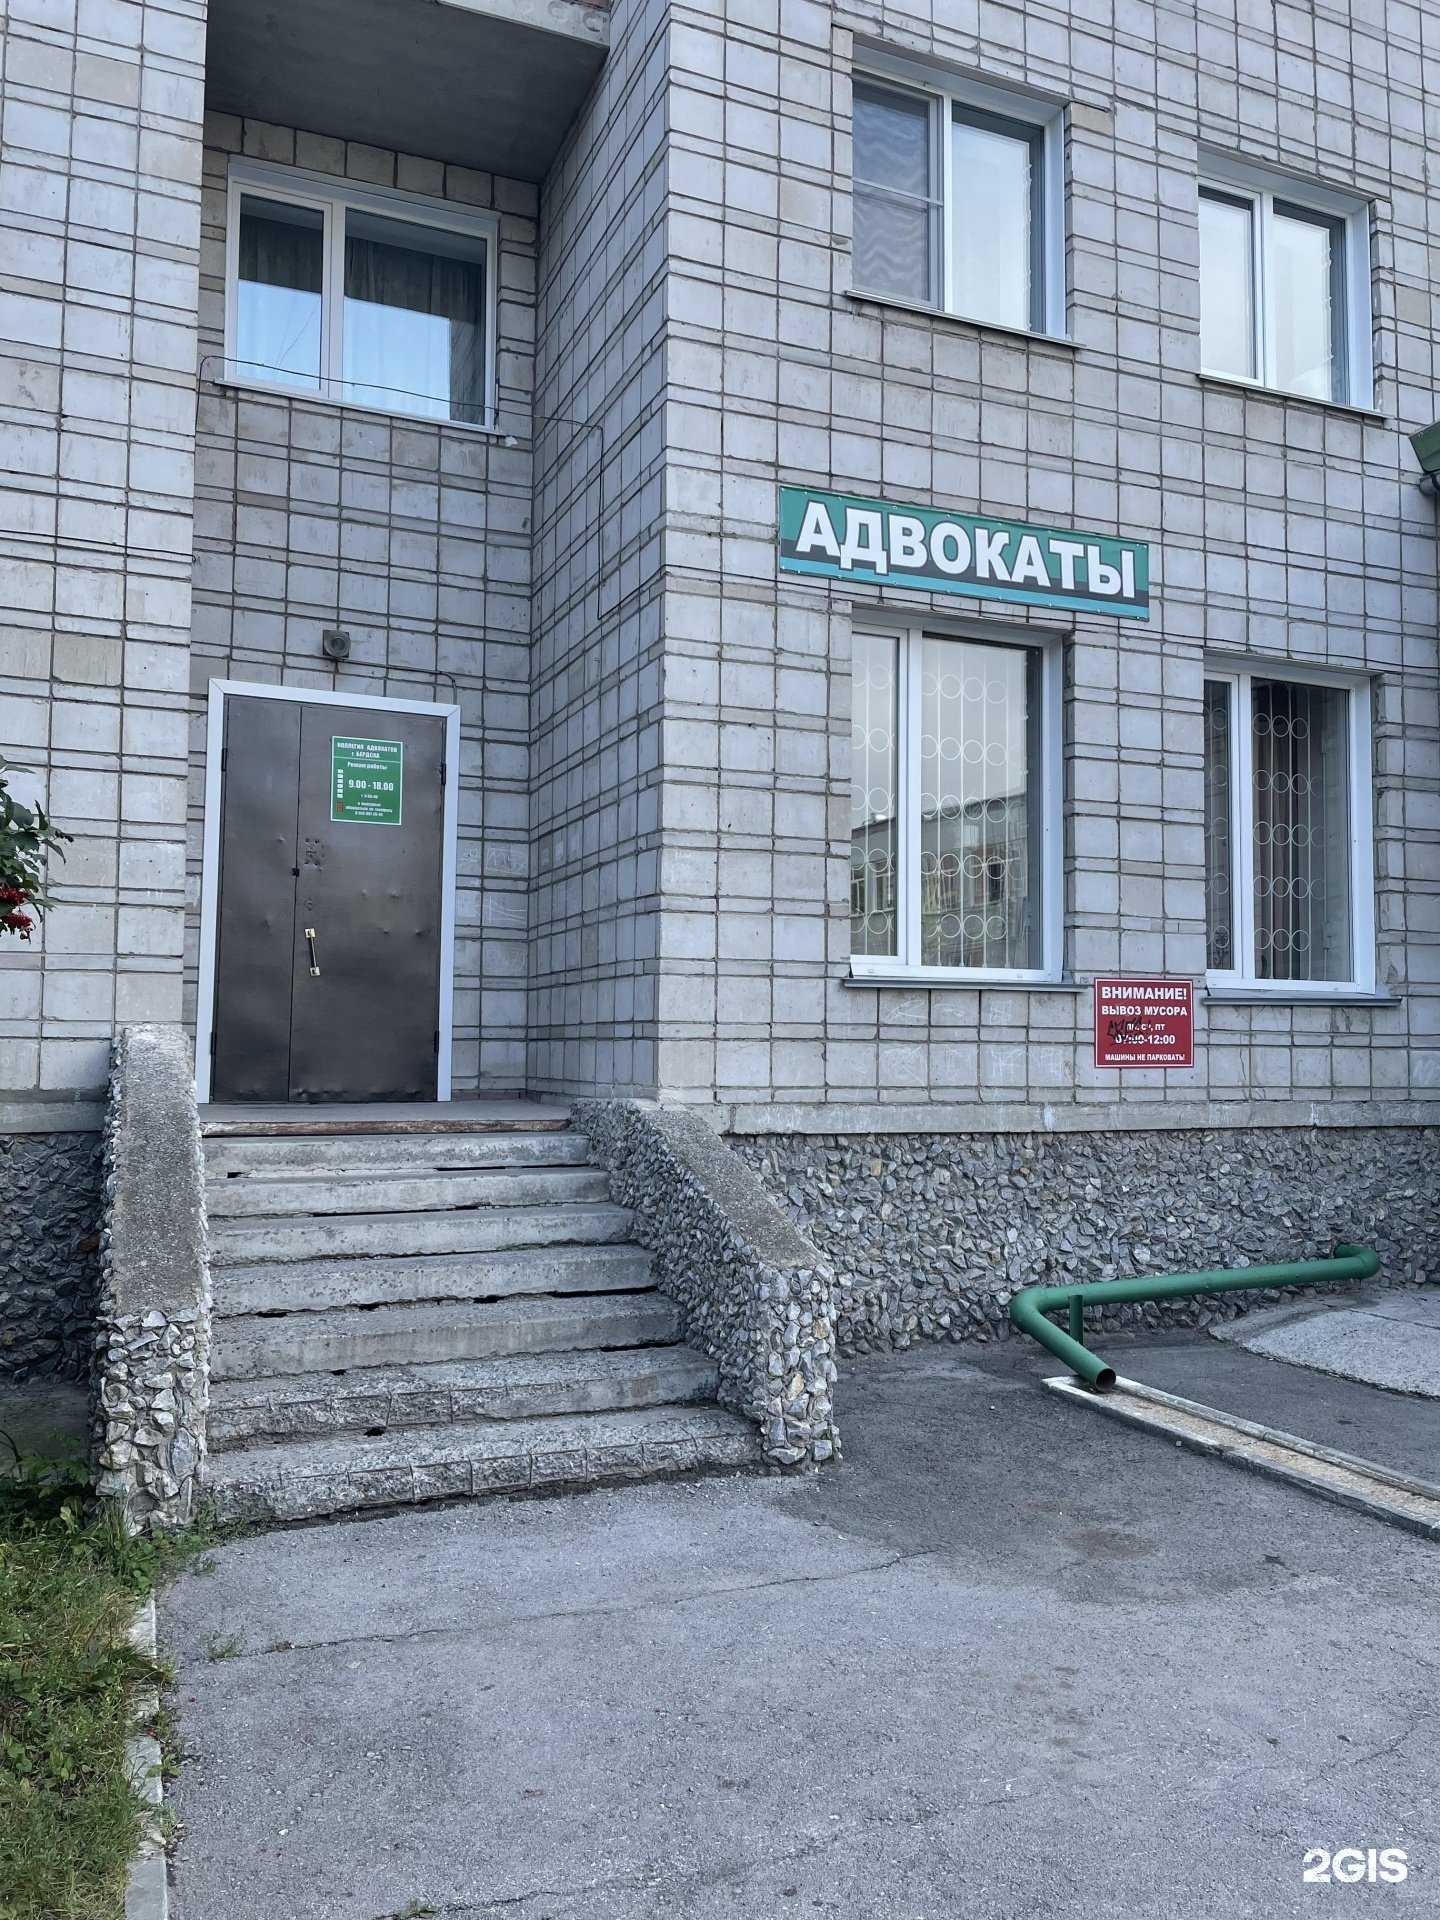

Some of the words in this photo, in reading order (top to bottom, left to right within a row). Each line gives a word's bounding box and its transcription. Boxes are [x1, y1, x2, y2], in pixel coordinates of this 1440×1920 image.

[795, 501, 1136, 599] АДВОКАТЫ
[348, 779, 367, 789] 9.00
[372, 781, 394, 791] 18.00
[1101, 986, 1187, 1000] ВНИМАНИЕ!
[1101, 1005, 1142, 1016] ВЫВОЗ
[1144, 1006, 1188, 1017] МУСОРА
[1104, 1053, 1136, 1061] МАШИНЫ
[1136, 1053, 1146, 1061] НЕ
